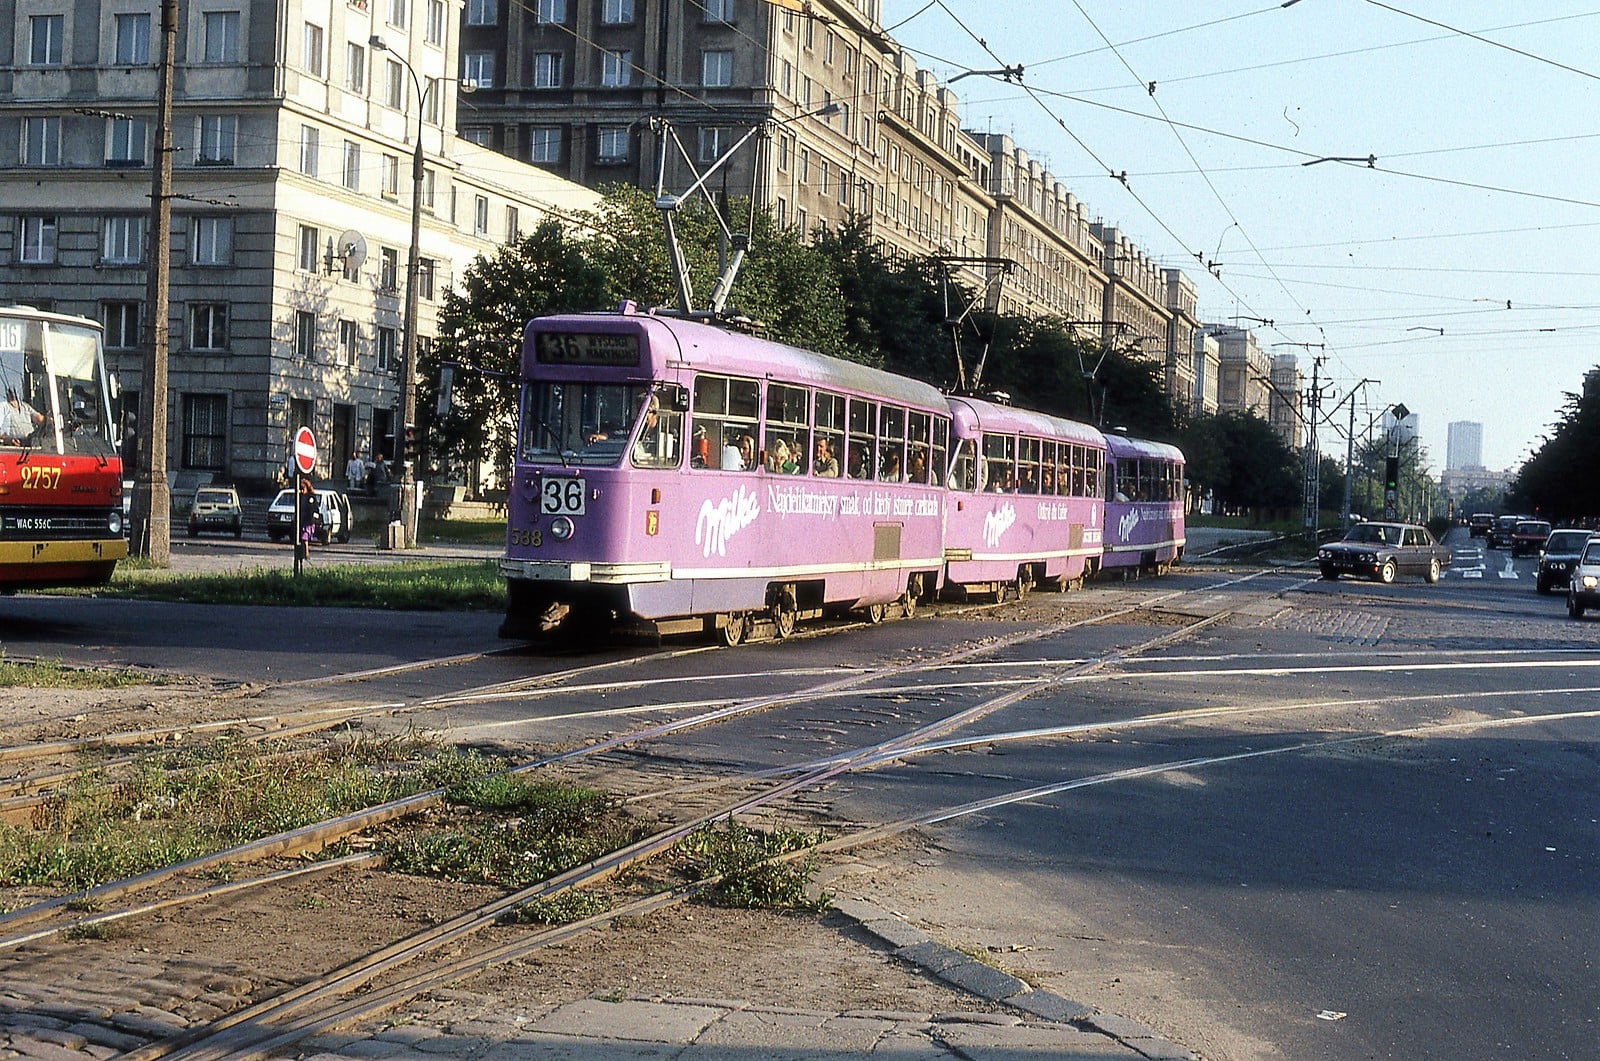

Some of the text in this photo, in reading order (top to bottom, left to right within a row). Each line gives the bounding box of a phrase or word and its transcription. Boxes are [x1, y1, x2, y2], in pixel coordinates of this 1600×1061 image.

[0, 323, 17, 348] 16
[550, 335, 580, 358] 36
[21, 466, 62, 490] 2757
[544, 480, 582, 512] 36
[863, 490, 873, 515] od
[874, 491, 892, 521] kiedy
[16, 519, 32, 529] WAC
[695, 484, 760, 558] Milka
[983, 501, 1016, 548] Milka
[511, 528, 543, 546] 588
